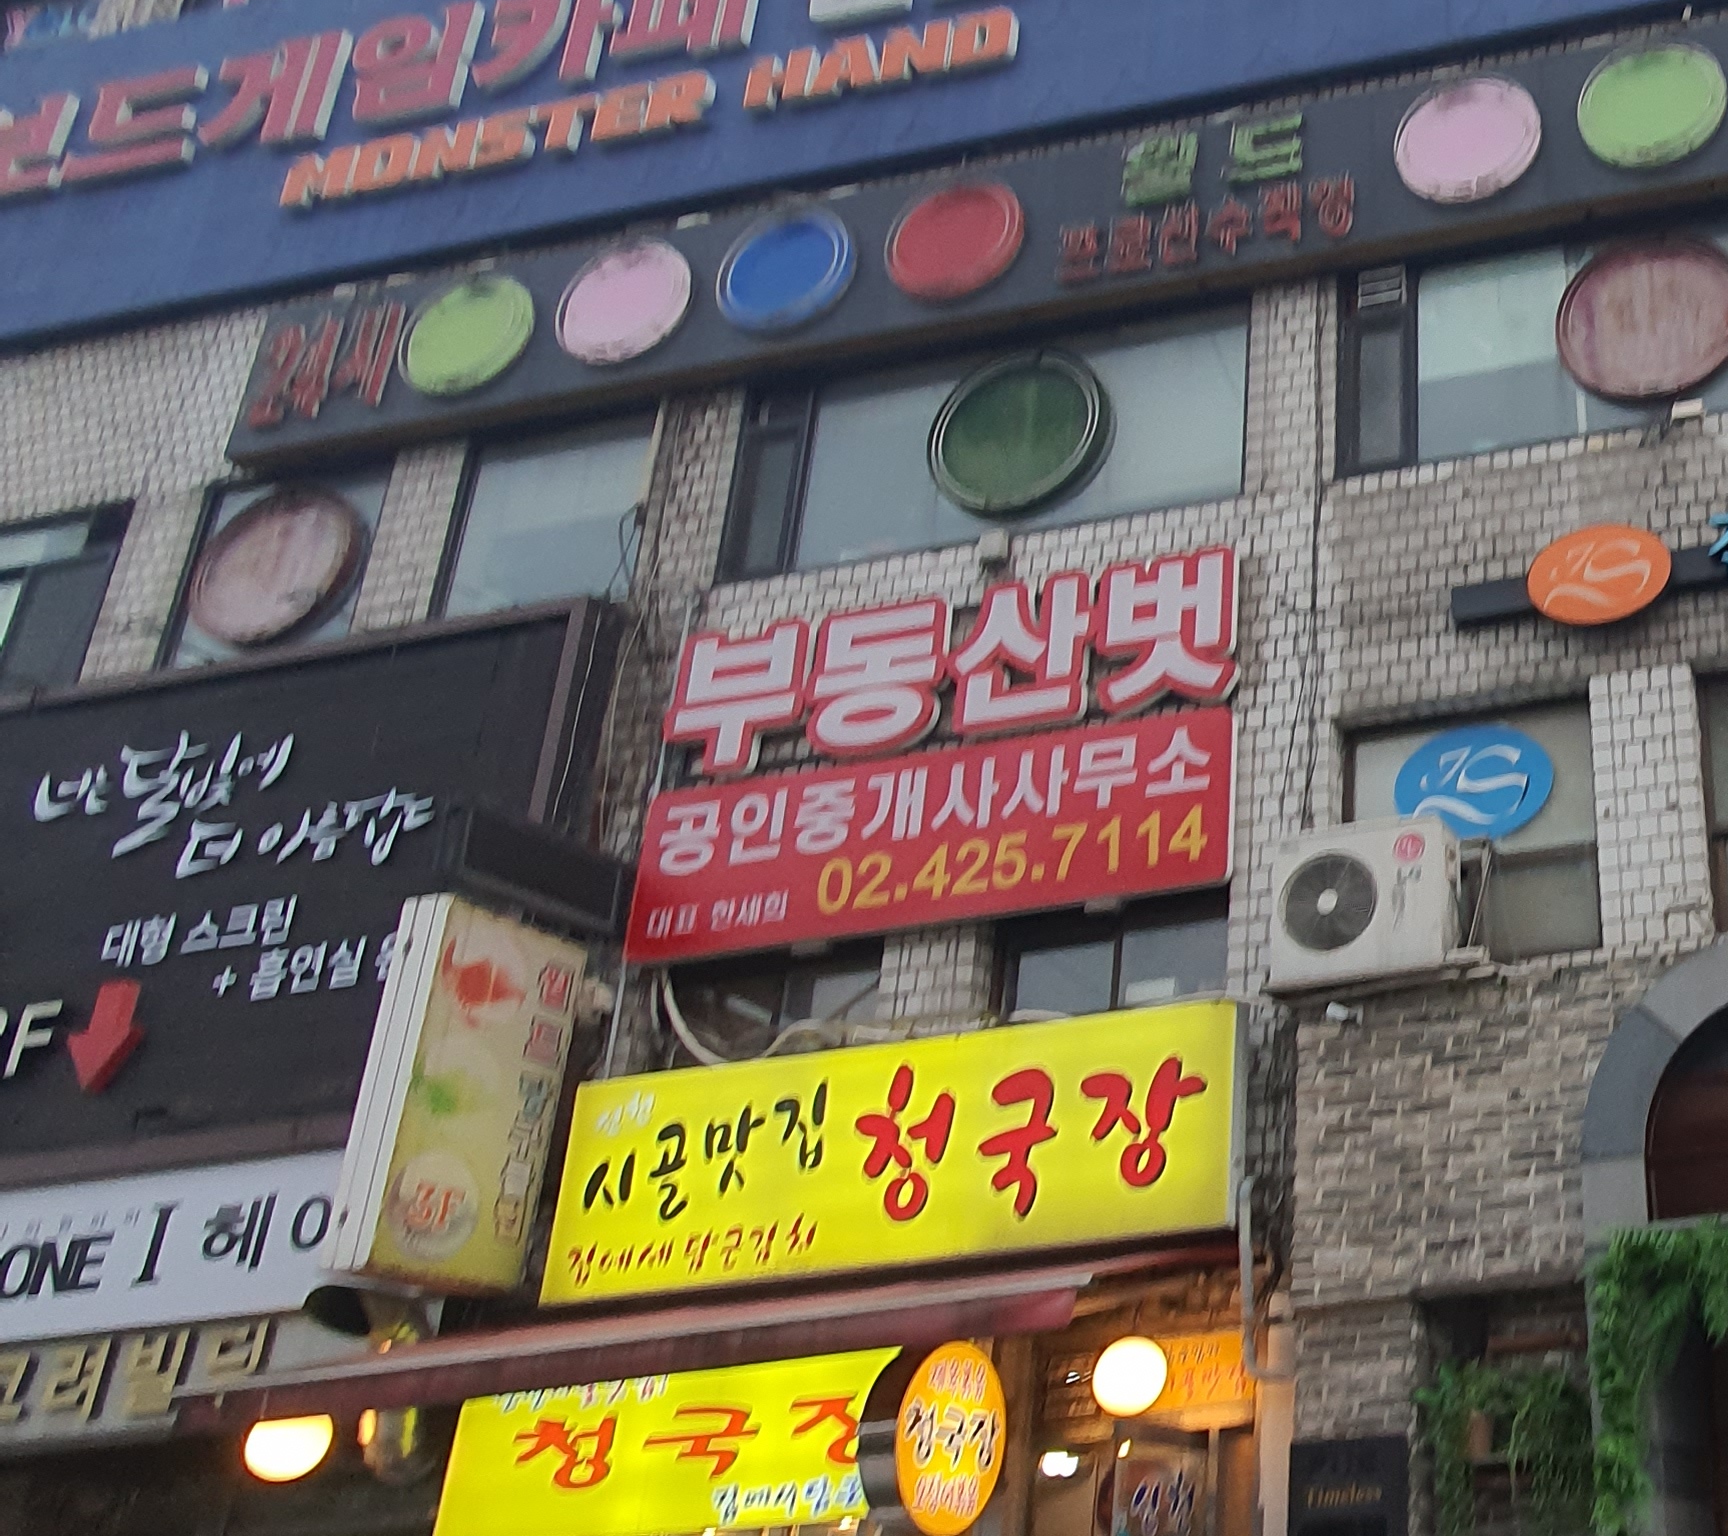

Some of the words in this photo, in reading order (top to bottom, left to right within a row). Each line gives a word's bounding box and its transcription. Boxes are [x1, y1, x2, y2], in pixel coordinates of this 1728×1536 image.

[280, 70, 716, 207] MONSTER
[743, 7, 1020, 112] HAND
[665, 546, 1240, 772] 부동산벗
[657, 732, 1213, 877] 공인중개사사무소
[815, 804, 1208, 917] 02.425.7114
[101, 911, 178, 968] 대형
[180, 894, 298, 955] 스크린
[0, 998, 63, 1080] F
[582, 1078, 829, 1222] 시골맛집
[855, 1055, 1208, 1222] 청국장
[904, 1398, 1001, 1470] 청국장
